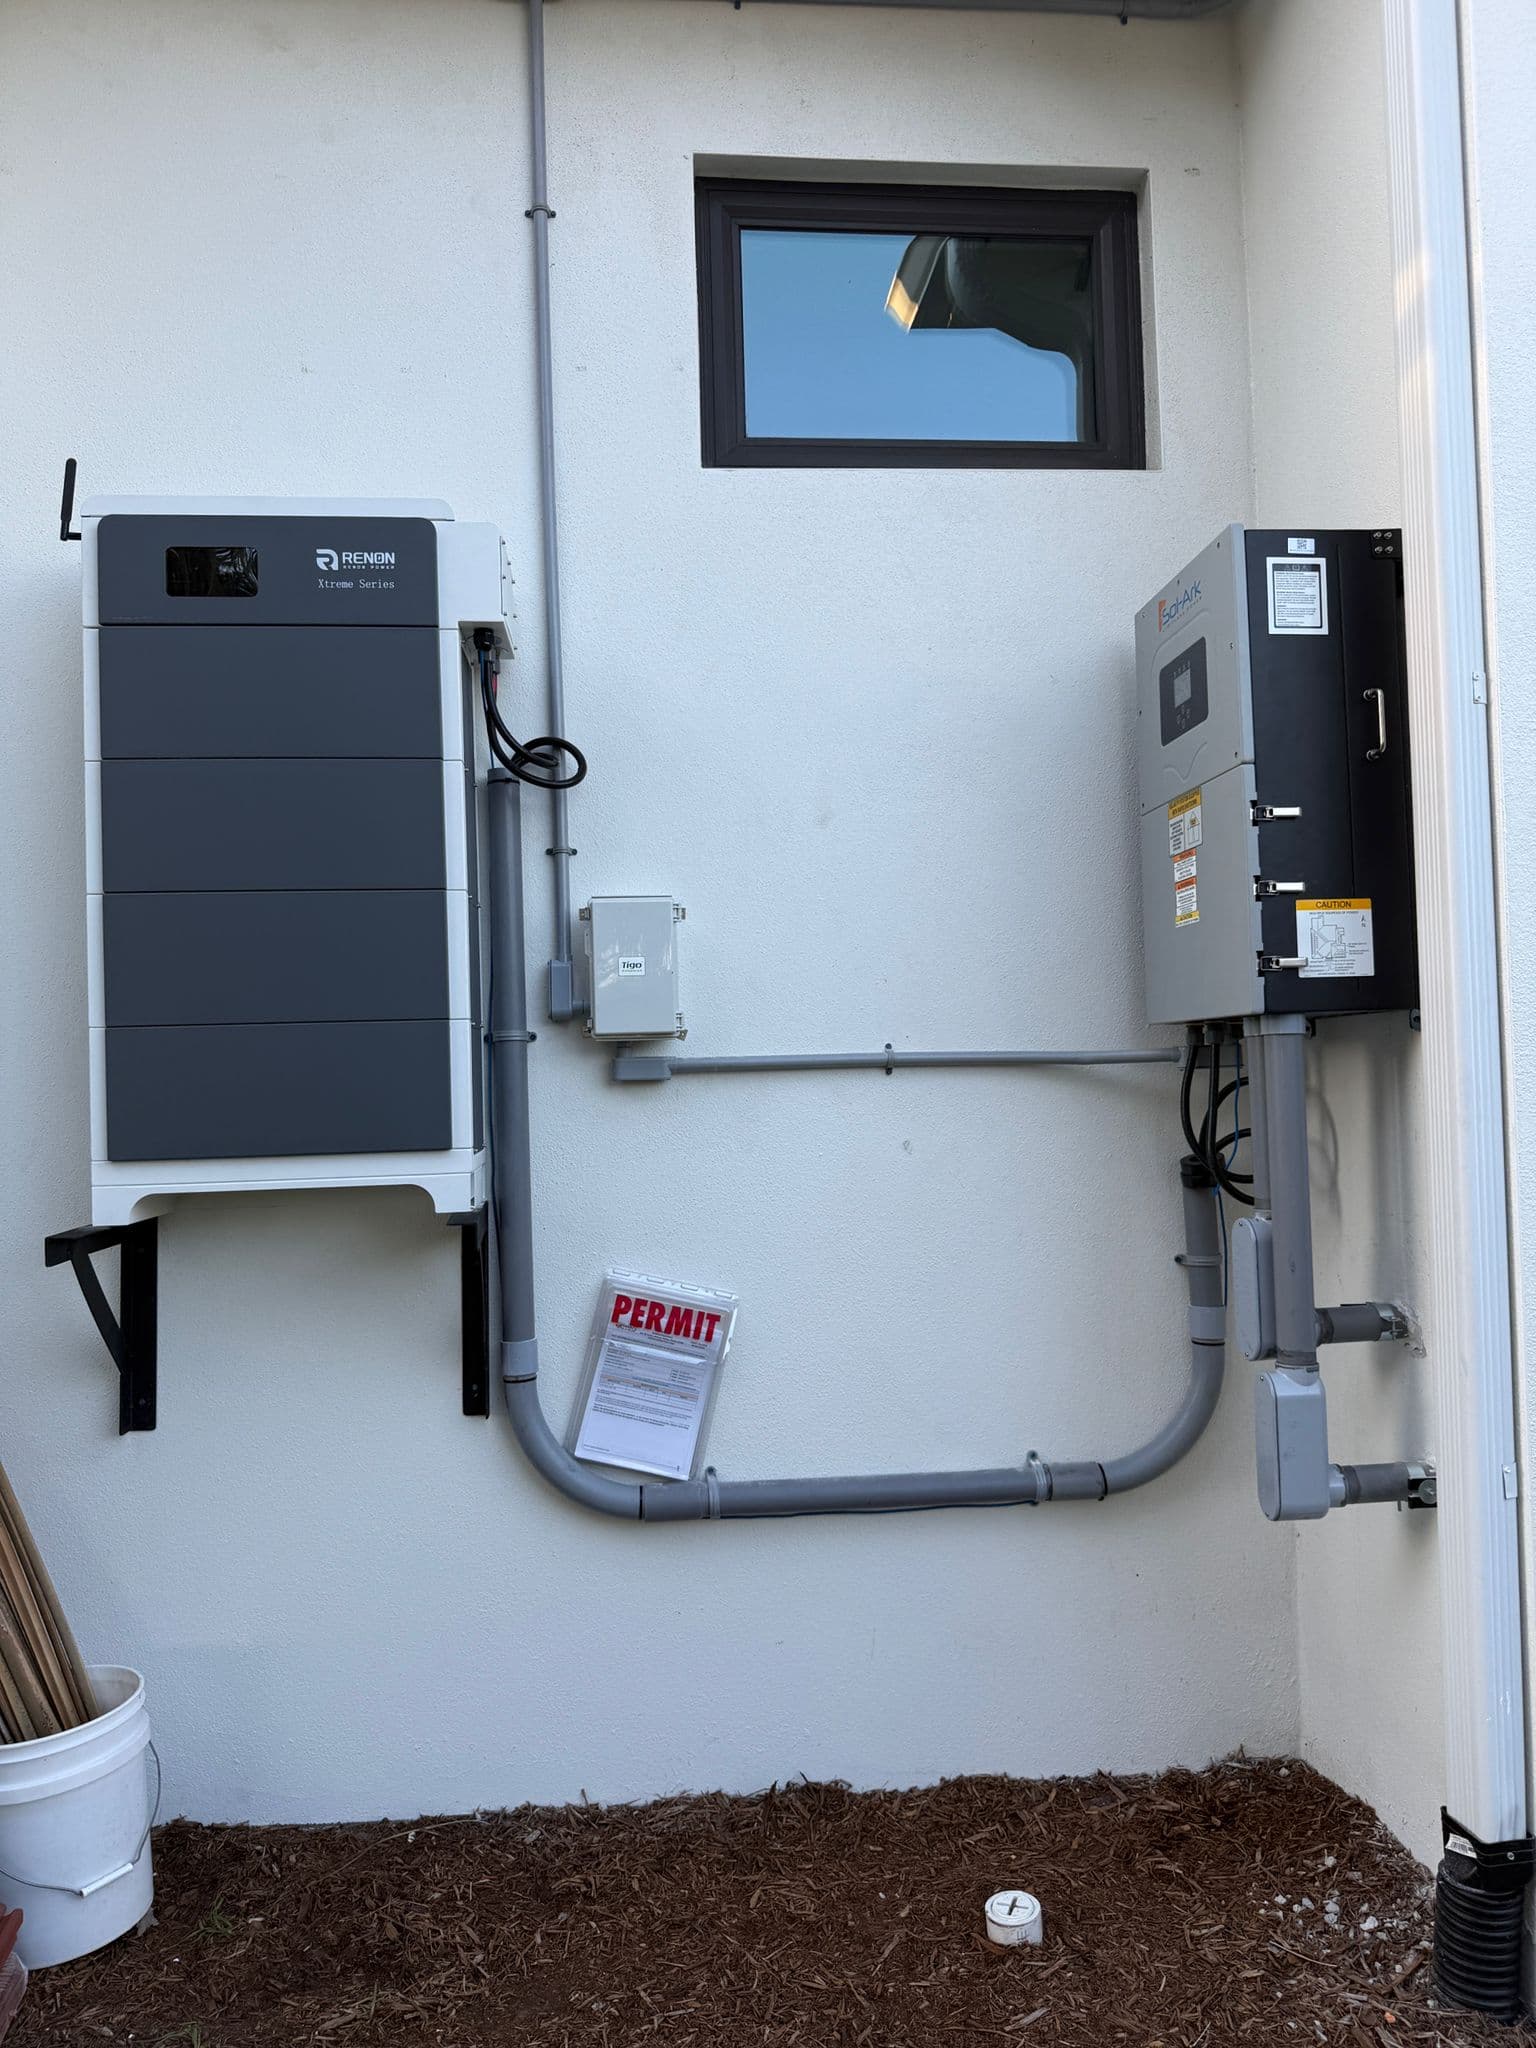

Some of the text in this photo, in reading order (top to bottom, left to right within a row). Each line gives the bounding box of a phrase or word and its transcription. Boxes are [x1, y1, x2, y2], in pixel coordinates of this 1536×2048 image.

[342, 552, 395, 564] RENON
[318, 578, 395, 589] Xtreme Series
[1315, 900, 1352, 909] CAUTION
[622, 961, 642, 970] Tigo
[611, 1294, 721, 1343] PERMIT
